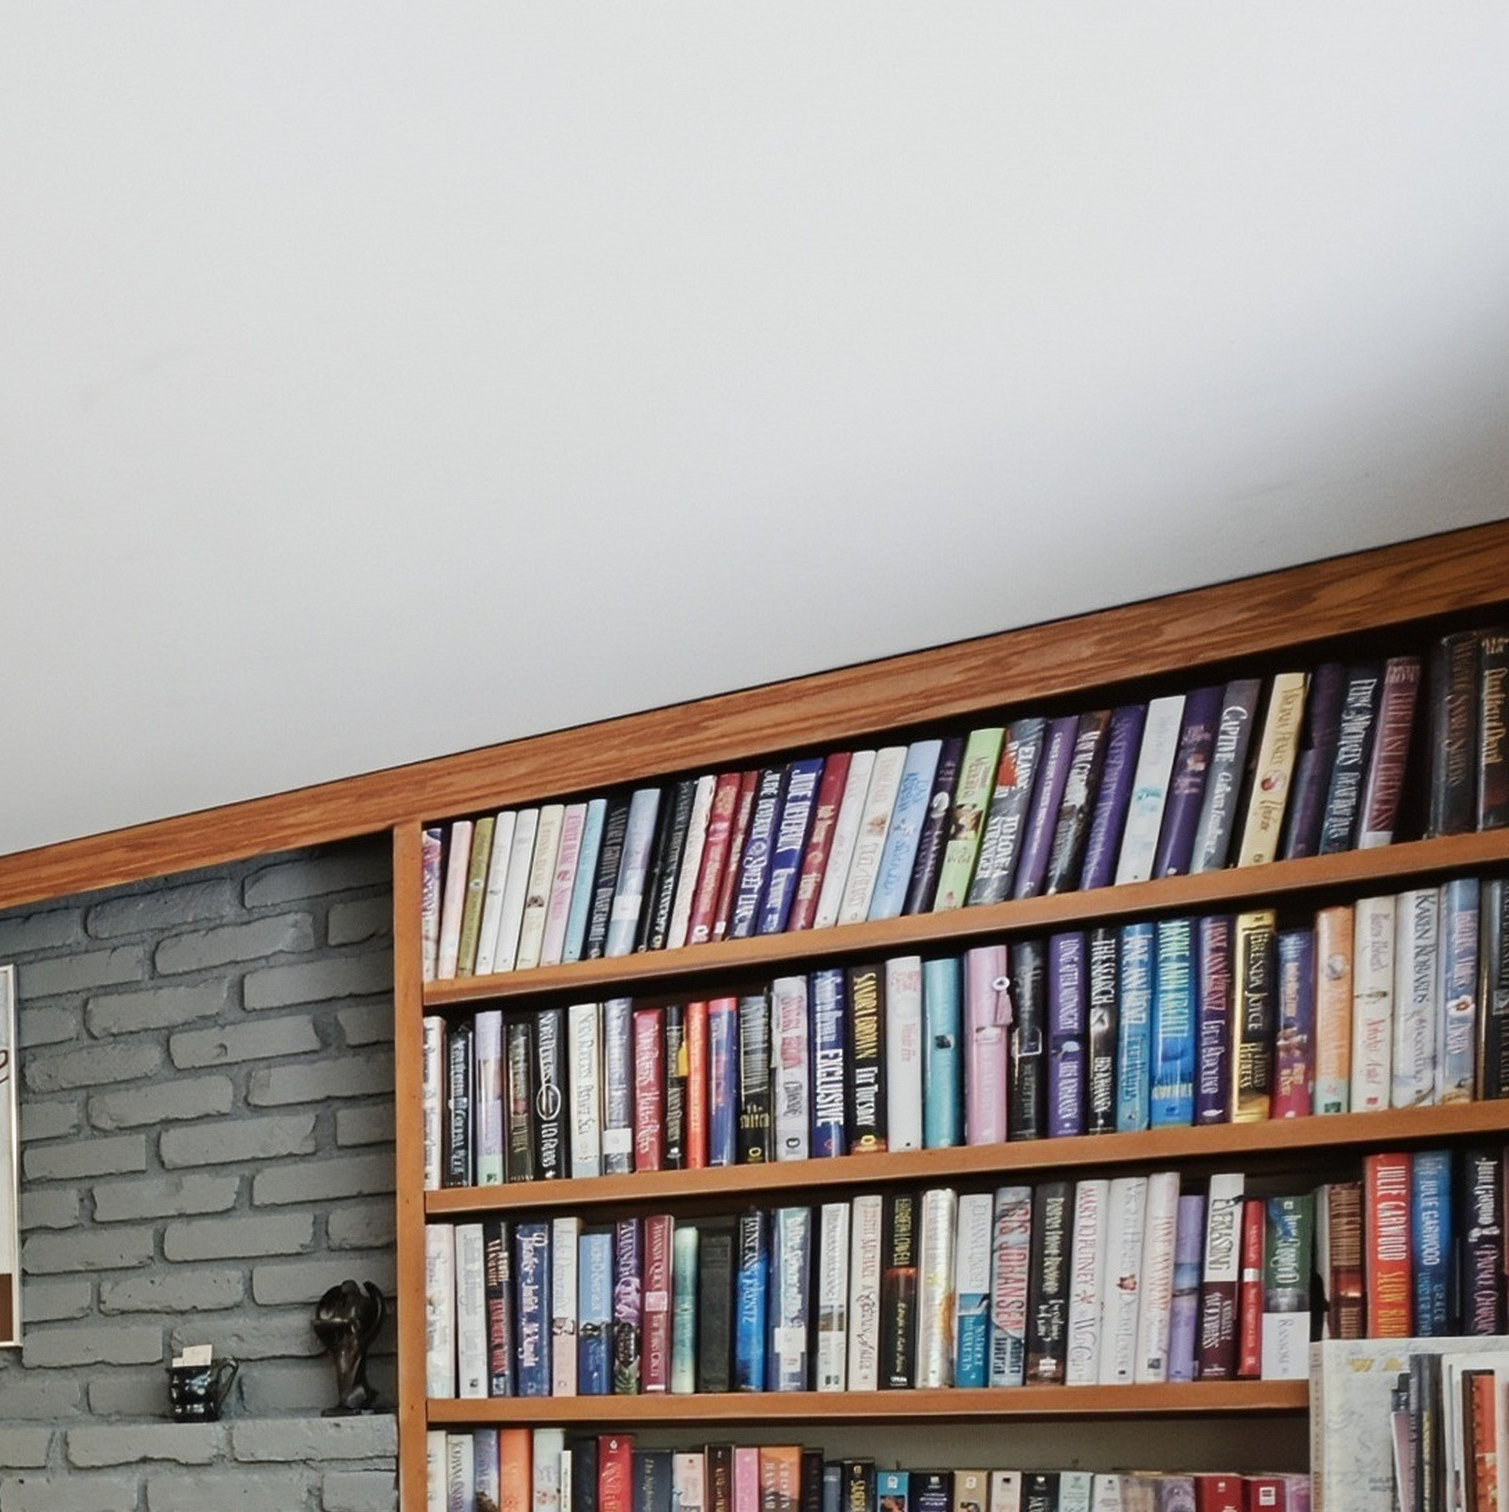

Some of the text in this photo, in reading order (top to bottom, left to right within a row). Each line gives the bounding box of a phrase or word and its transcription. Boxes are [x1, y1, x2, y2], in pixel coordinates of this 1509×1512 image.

[1215, 706, 1247, 762] CAPTIVE
[761, 770, 780, 796] JUDE
[788, 770, 816, 799] JUDE
[977, 816, 1001, 879] STRANGER
[1092, 939, 1115, 960] THE
[1413, 894, 1436, 1003] KAREN ROBARDS
[1092, 961, 1114, 1005] SEARCH
[1159, 921, 1190, 1037] JAYNE ANN KRENTZ
[1245, 933, 1267, 1031] BRENDA JOYCE
[816, 1049, 844, 1127] EXCLUSIVE
[856, 1084, 878, 1126] TUESDAY
[1377, 1165, 1406, 1196] JULIE
[1079, 1187, 1095, 1221] MARY
[1421, 1180, 1439, 1265] JULIE GARWOOD
[1377, 1201, 1406, 1260] GARWOOD
[996, 1200, 1030, 1330] IRIS JOHANSEN
[1076, 1239, 1093, 1286] PUTNEY
[1377, 1271, 1405, 1302] SLOW
[765, 1463, 775, 1509] HANNAH
[780, 1463, 790, 1509] KRISTIN
